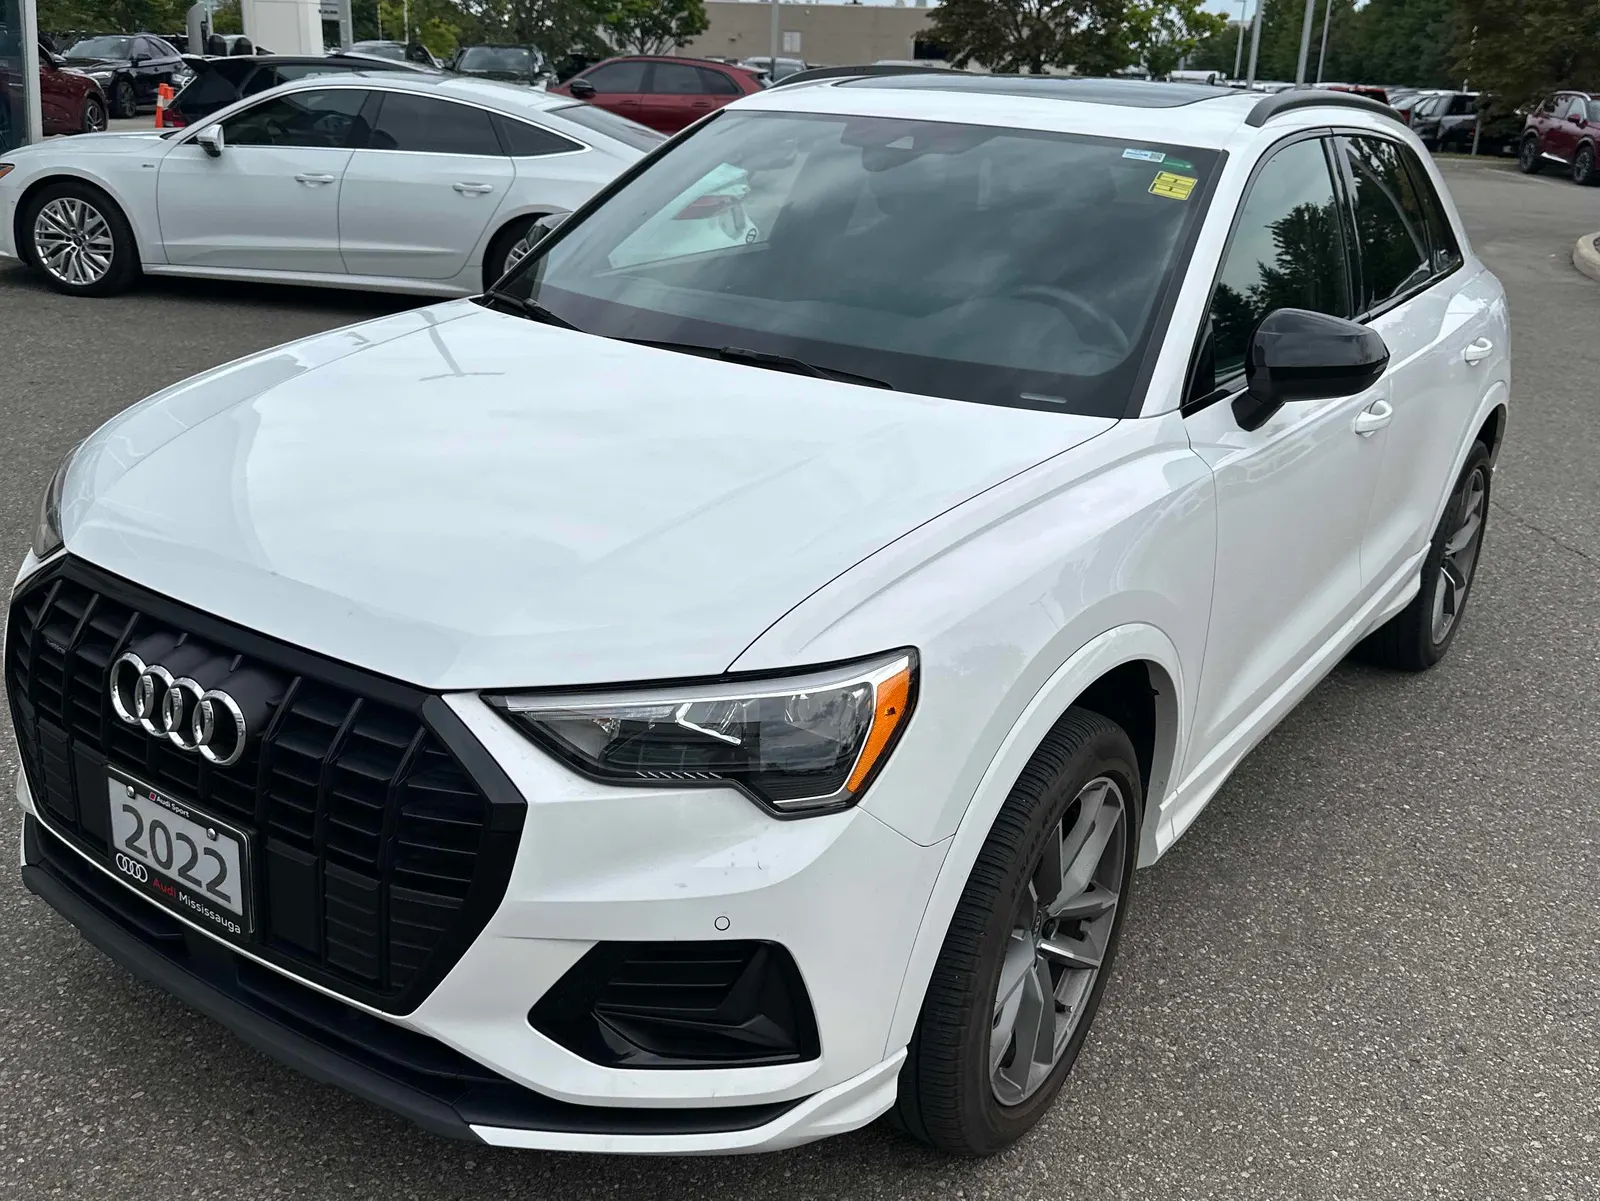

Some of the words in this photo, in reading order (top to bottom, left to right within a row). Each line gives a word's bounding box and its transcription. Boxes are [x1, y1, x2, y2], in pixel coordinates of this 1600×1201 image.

[156, 796, 171, 809] Audi
[171, 803, 190, 818] Sport
[122, 803, 232, 904] 2022
[152, 877, 177, 898] Audi
[178, 891, 242, 934] Mississauga
